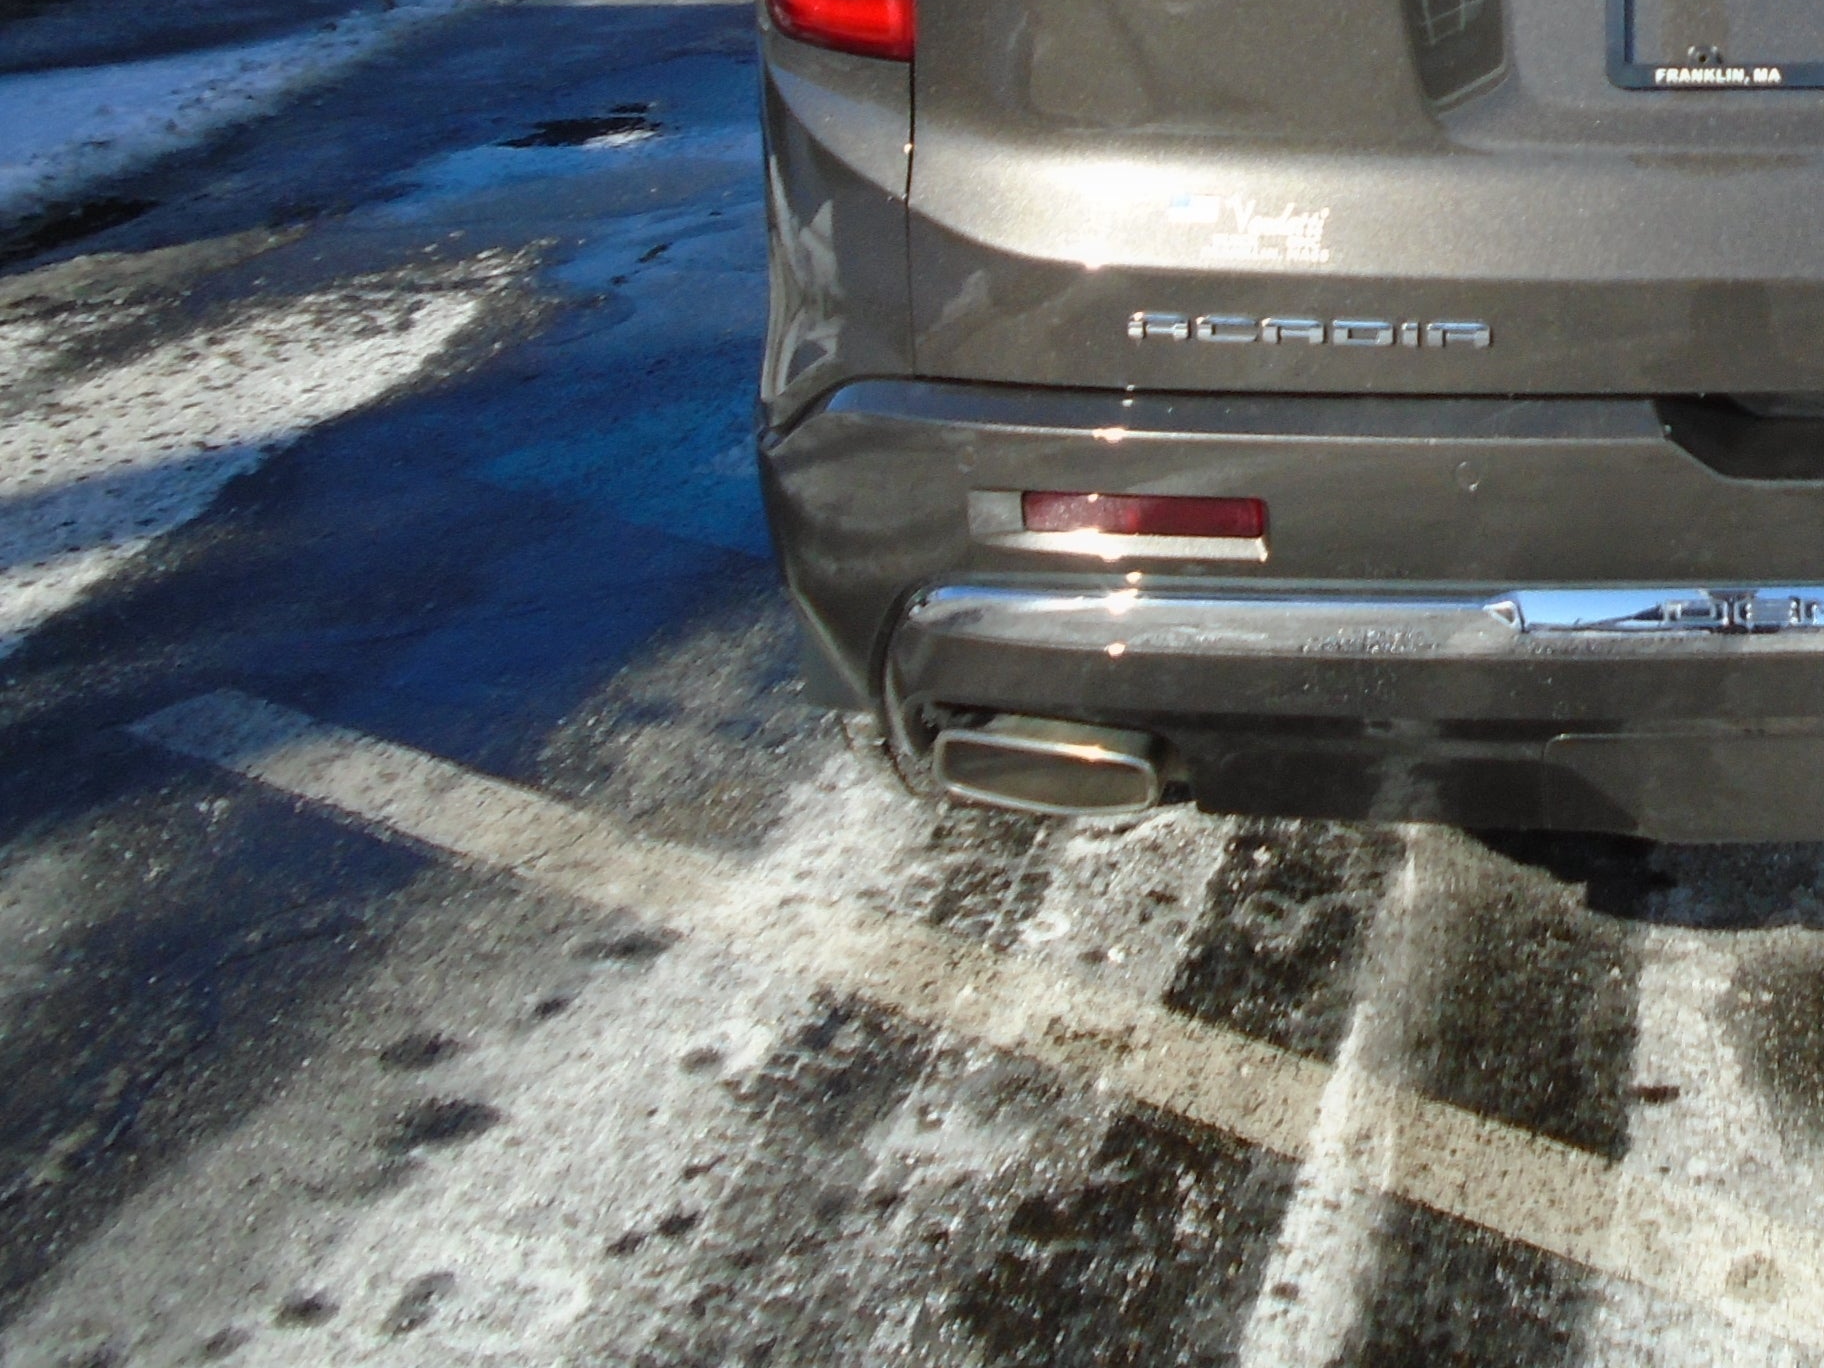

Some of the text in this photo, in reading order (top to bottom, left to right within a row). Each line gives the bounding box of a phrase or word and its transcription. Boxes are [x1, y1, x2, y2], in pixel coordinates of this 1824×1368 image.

[1655, 67, 1781, 85] FRANKLIN, MA
[1127, 311, 1491, 348] ACADIA
